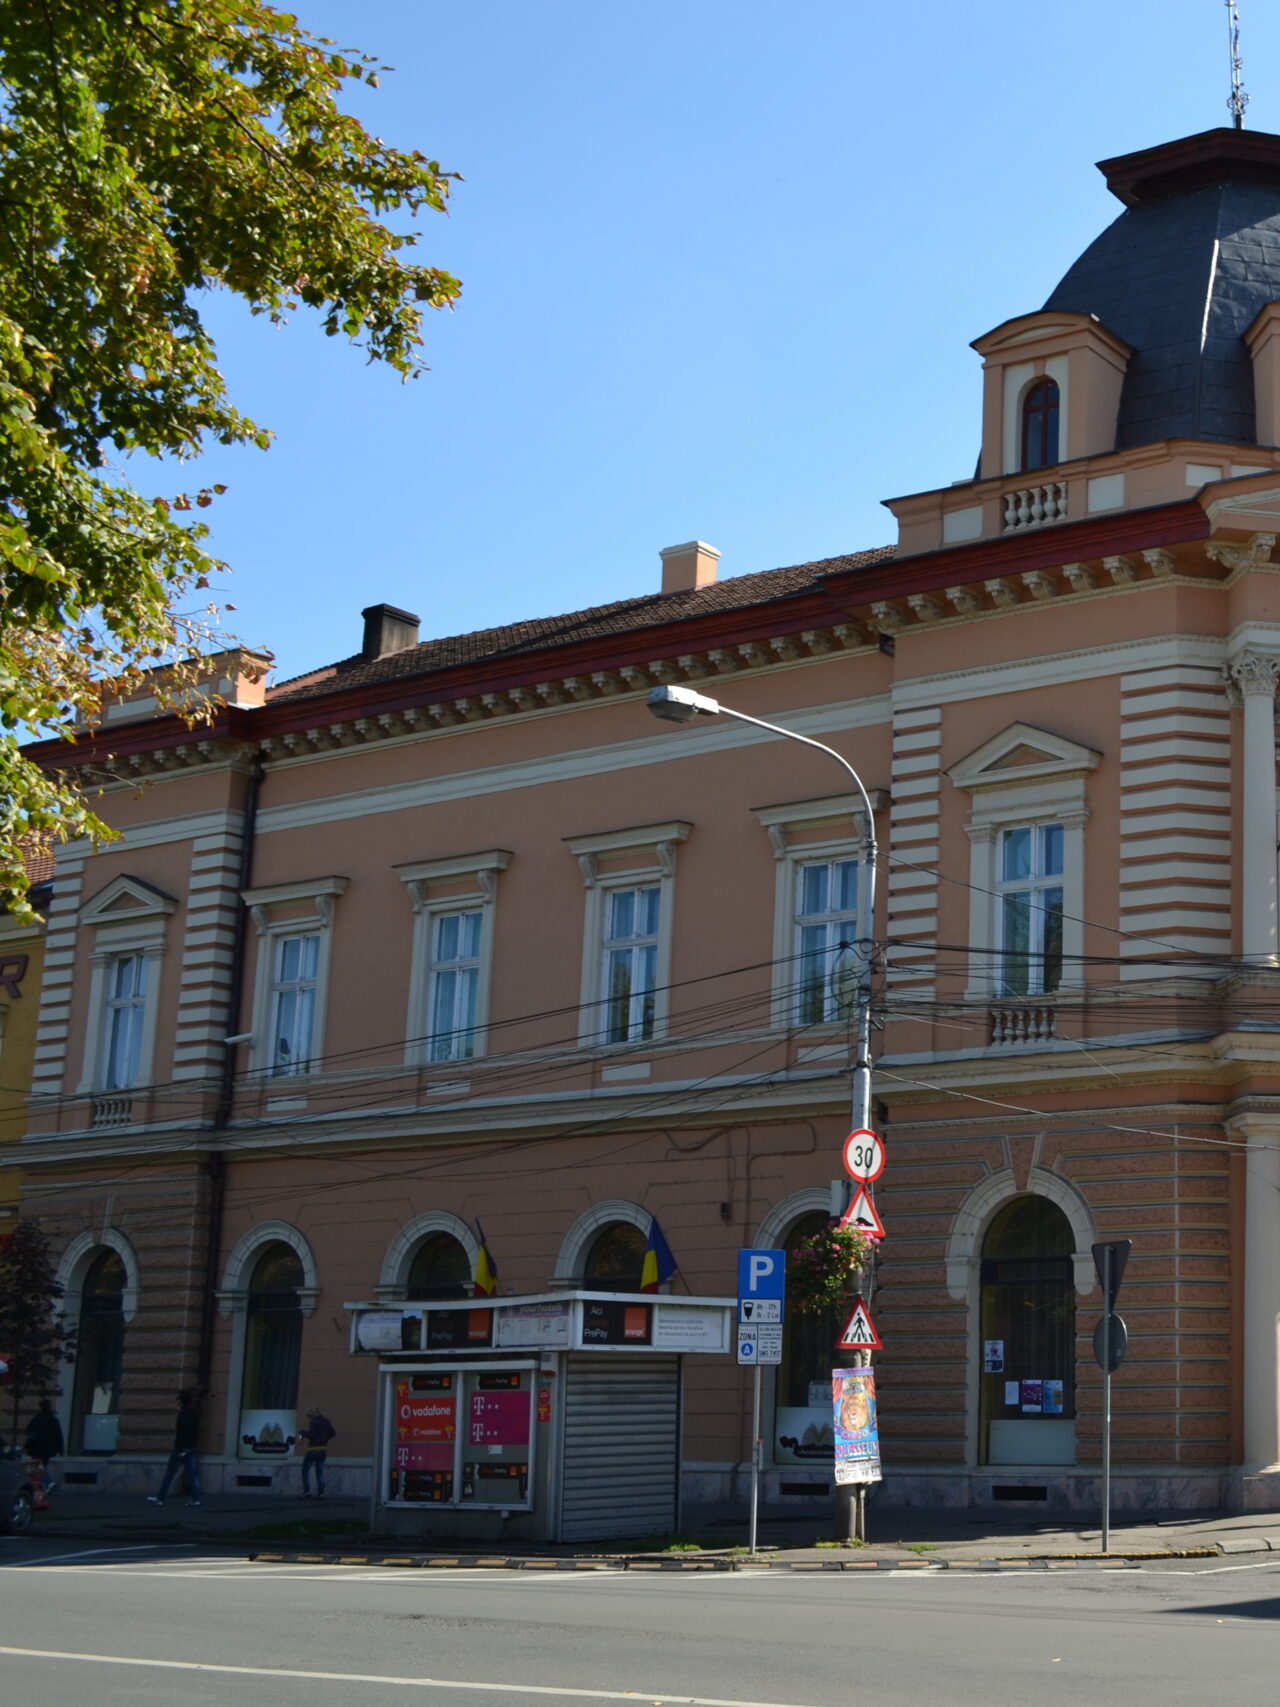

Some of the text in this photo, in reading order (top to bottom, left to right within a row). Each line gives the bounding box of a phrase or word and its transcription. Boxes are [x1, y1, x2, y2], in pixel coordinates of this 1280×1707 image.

[854, 1145, 873, 1168] 30
[749, 1255, 774, 1291] P
[584, 1327, 609, 1340] PrePay
[739, 1332, 756, 1341] ZONA
[742, 1344, 752, 1355] A
[412, 1404, 452, 1417] vodafone
